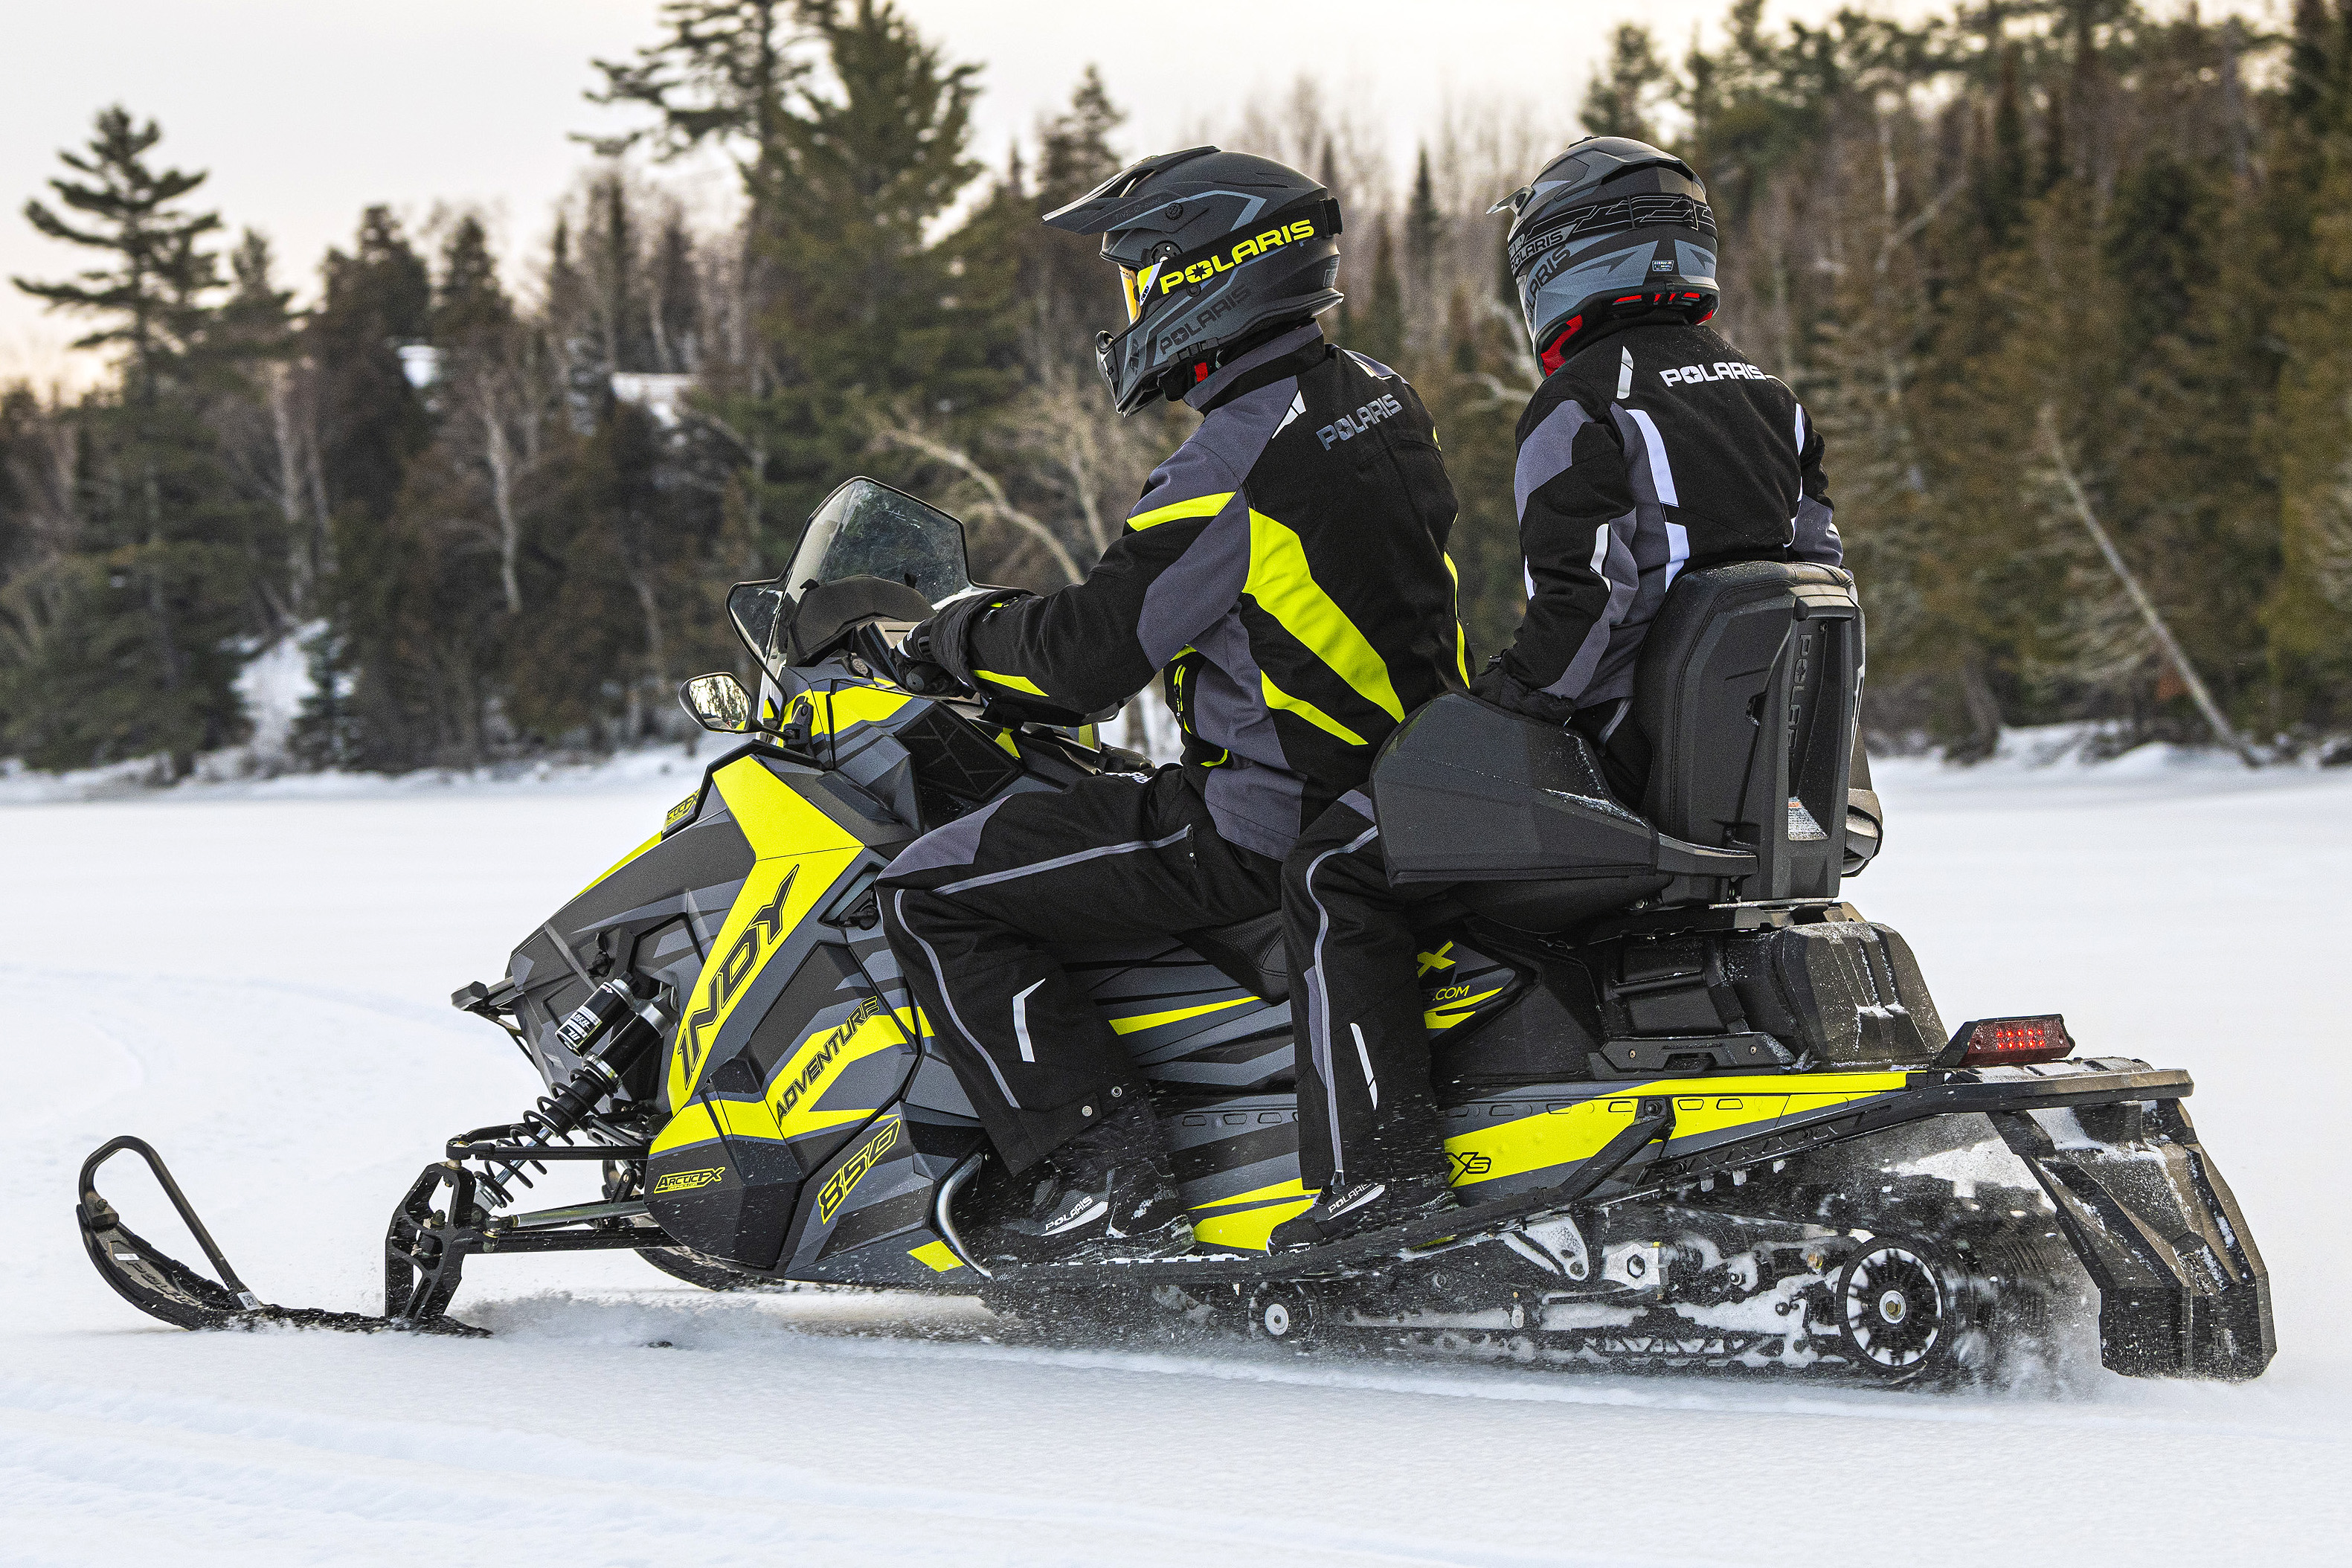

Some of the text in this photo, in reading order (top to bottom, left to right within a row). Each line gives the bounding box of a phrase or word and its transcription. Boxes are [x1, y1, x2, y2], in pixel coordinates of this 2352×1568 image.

[1160, 219, 1314, 295] POLARIS
[1160, 283, 1251, 355] POLARIS
[1659, 362, 1767, 388] POLARIS
[1317, 393, 1404, 451] POLARIS
[1788, 634, 1813, 768] POLAR
[675, 864, 800, 1090] INDY
[776, 995, 880, 1125] ADVENTURE
[817, 1119, 901, 1224] 850
[1046, 1195, 1093, 1231] POLARIS
